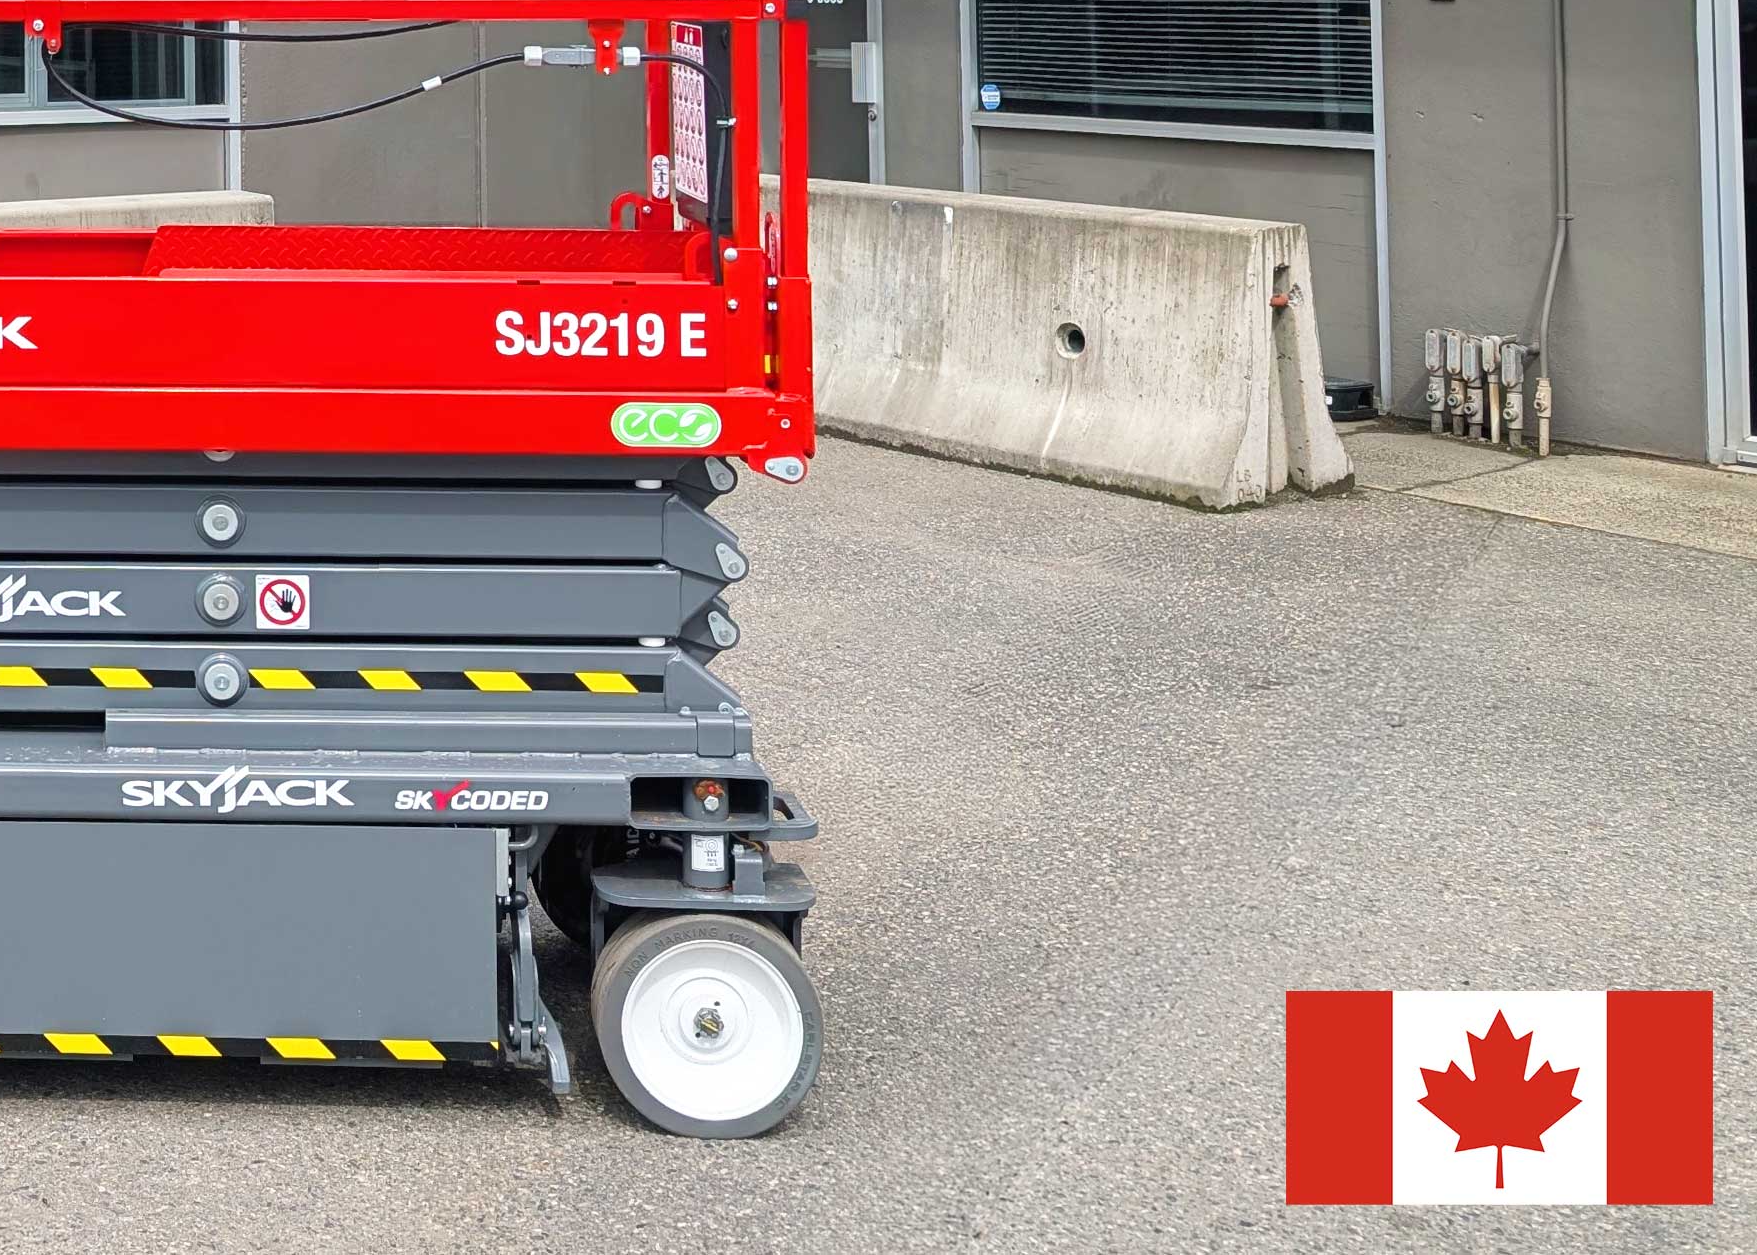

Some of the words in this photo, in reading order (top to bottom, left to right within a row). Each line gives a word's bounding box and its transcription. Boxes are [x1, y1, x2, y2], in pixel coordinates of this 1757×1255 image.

[494, 310, 665, 357] SJ3219
[680, 312, 707, 357] E
[619, 408, 712, 442] eco
[121, 764, 355, 813] SKYJACK
[394, 780, 549, 812] SKYCODED
